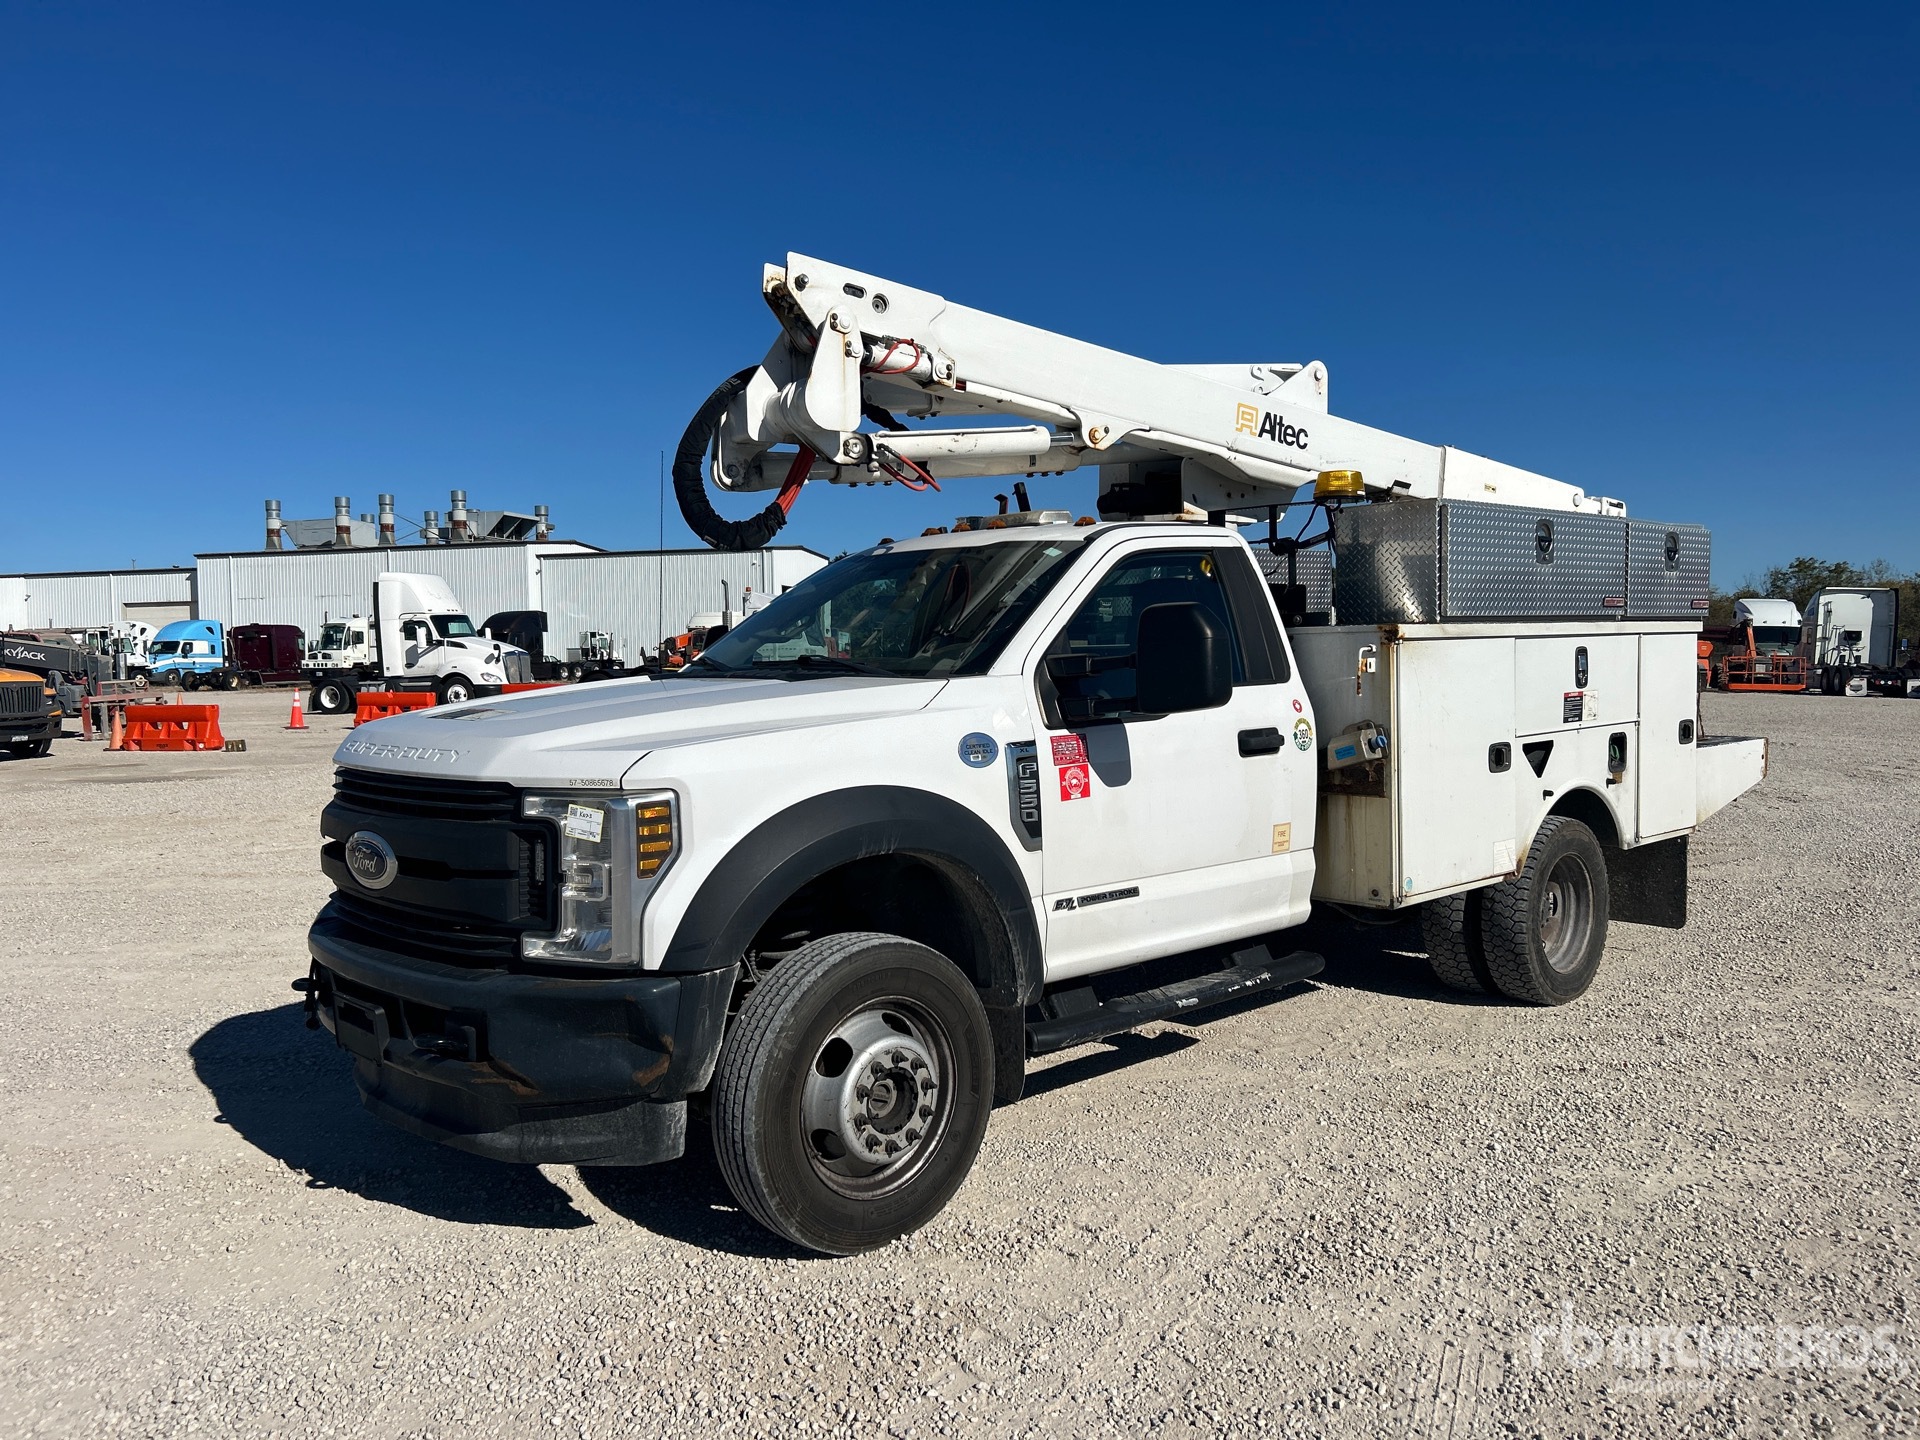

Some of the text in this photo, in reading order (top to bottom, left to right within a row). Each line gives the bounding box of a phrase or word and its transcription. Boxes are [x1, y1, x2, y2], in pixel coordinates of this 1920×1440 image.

[1257, 411, 1309, 450] Altec
[3, 646, 46, 661] KYJACK
[343, 740, 460, 763] SUPER DUTY
[353, 845, 378, 873] Ford
[1080, 893, 1108, 904] POWER
[1108, 887, 1139, 898] STROKE
